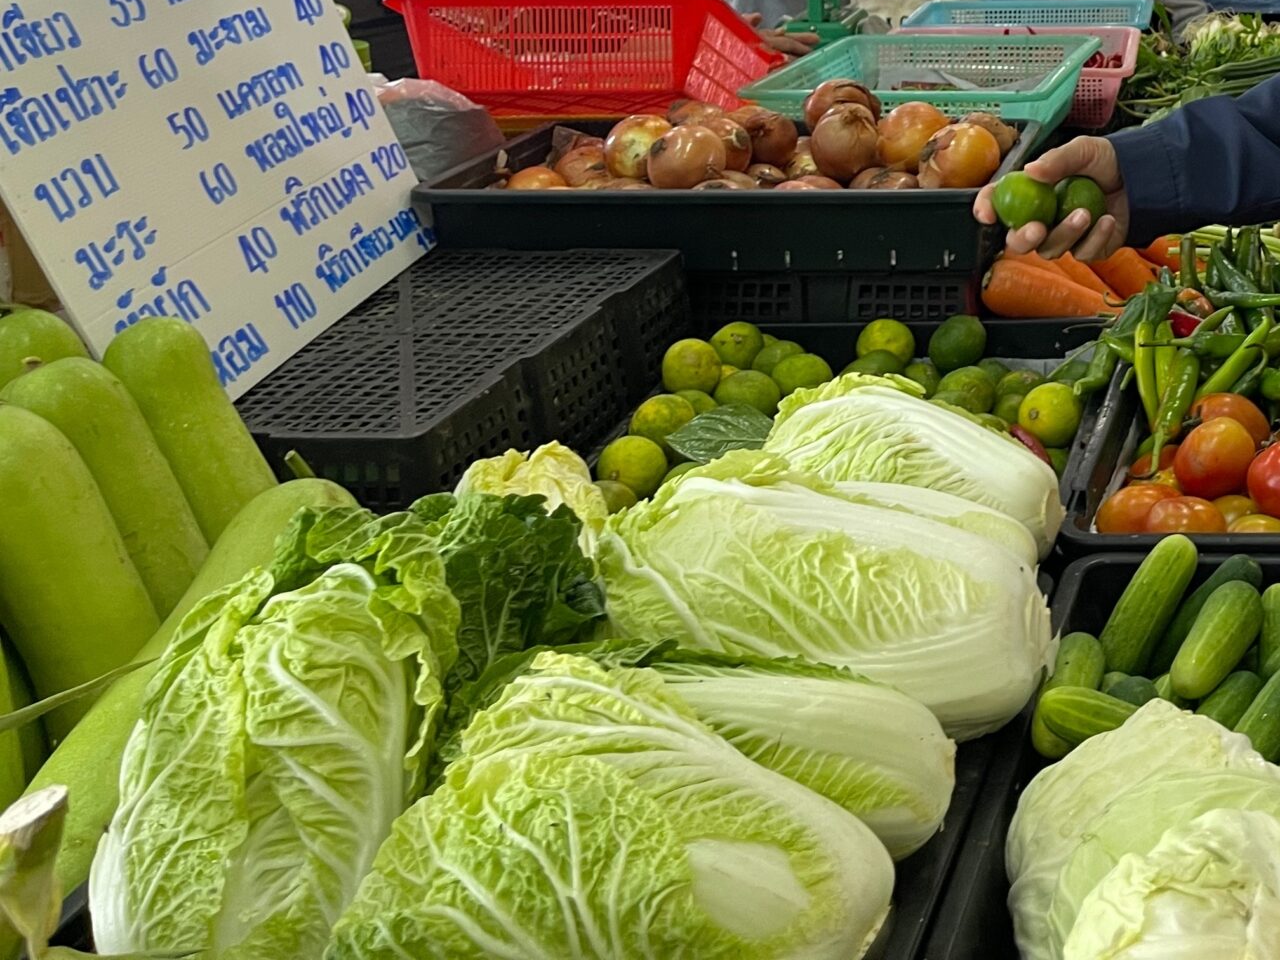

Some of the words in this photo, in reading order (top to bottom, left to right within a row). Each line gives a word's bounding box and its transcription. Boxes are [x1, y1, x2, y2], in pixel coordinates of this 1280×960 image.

[139, 48, 178, 89] 60
[319, 42, 350, 78] 40
[345, 88, 375, 130] 40
[34, 153, 120, 222] บวบ
[167, 107, 209, 150] 50
[371, 143, 407, 181] 120
[199, 162, 238, 205] 60
[238, 227, 278, 273] 40
[274, 282, 317, 329] 110
